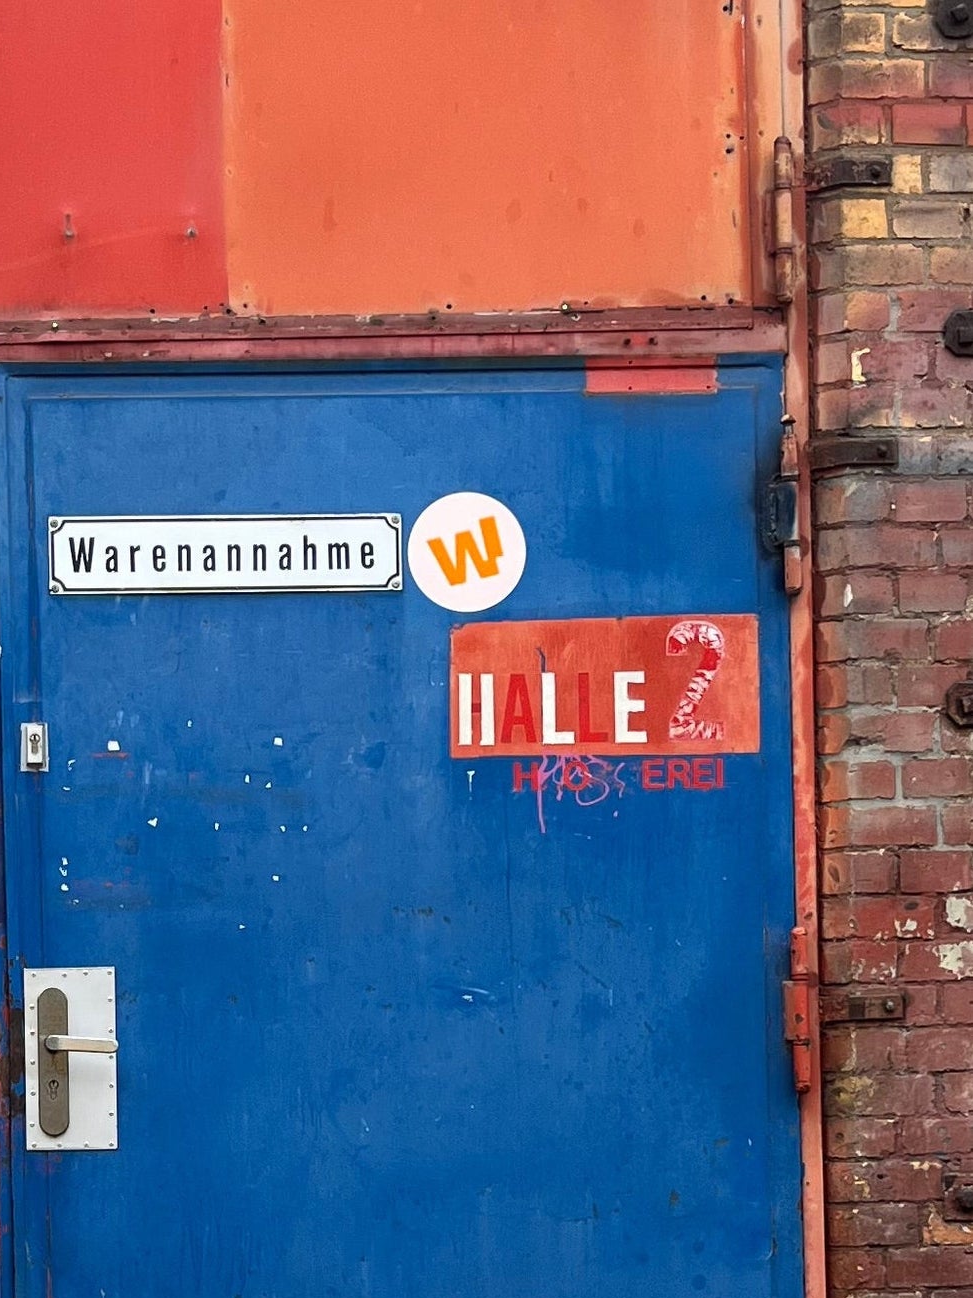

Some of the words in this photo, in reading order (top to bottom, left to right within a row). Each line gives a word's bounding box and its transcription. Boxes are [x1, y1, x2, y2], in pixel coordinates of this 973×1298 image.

[68, 535, 376, 573] Warenannahme
[426, 516, 503, 587] W
[457, 670, 648, 746] HALLE
[665, 620, 726, 741] 2
